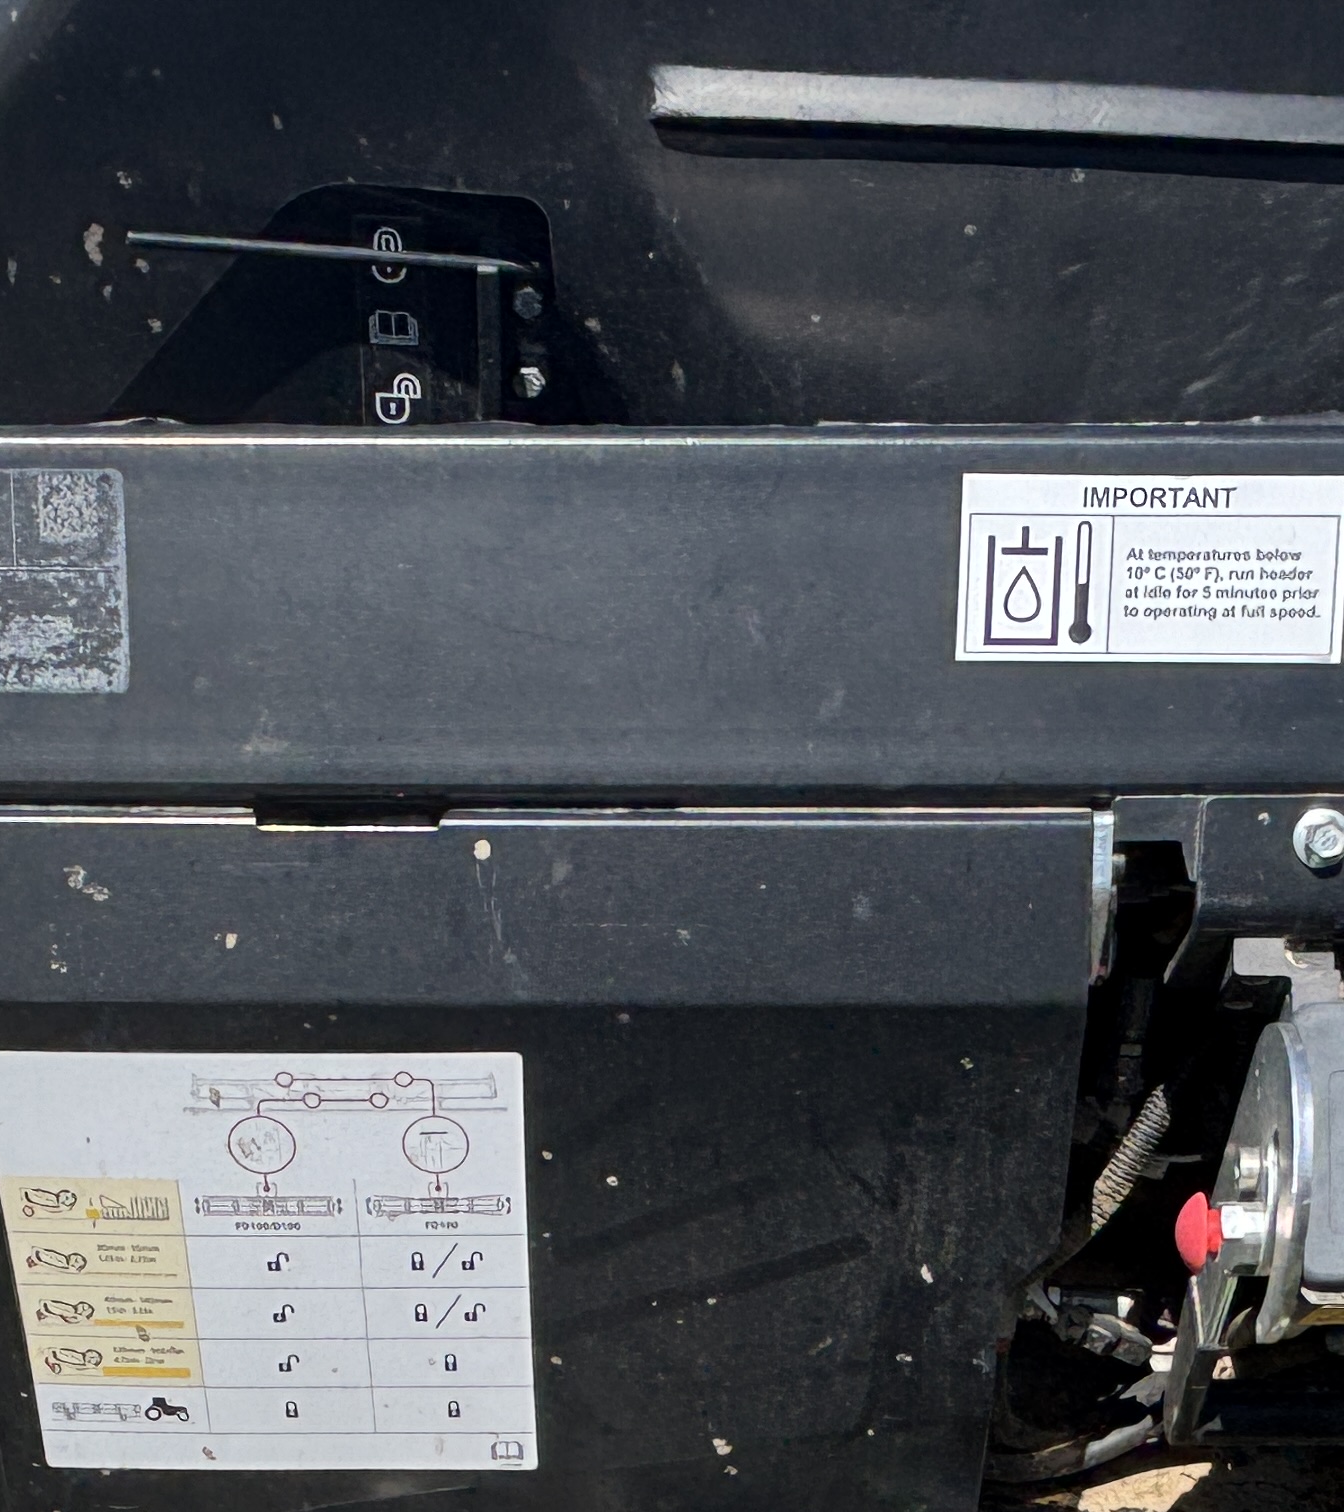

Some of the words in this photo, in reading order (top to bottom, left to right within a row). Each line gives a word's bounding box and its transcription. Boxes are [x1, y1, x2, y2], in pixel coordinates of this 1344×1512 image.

[1083, 486, 1236, 509] IMPORTANT
[1127, 548, 1143, 561] At
[1149, 549, 1251, 563] temperatures
[1256, 548, 1302, 561] below
[1126, 566, 1150, 580] 10°
[1154, 566, 1166, 580] C
[1171, 566, 1200, 582] (50°
[1229, 570, 1254, 580] run
[1260, 566, 1313, 580] header
[1125, 586, 1138, 599] at
[1144, 586, 1171, 599] idle
[1176, 585, 1198, 598] for
[1202, 586, 1211, 598] 5
[1216, 586, 1277, 599] minutes
[1283, 586, 1319, 602] prior
[1124, 605, 1138, 617] to
[1144, 605, 1217, 620] operating
[1221, 605, 1236, 618] at
[1241, 604, 1265, 618] full
[1270, 605, 1321, 620] speed.
